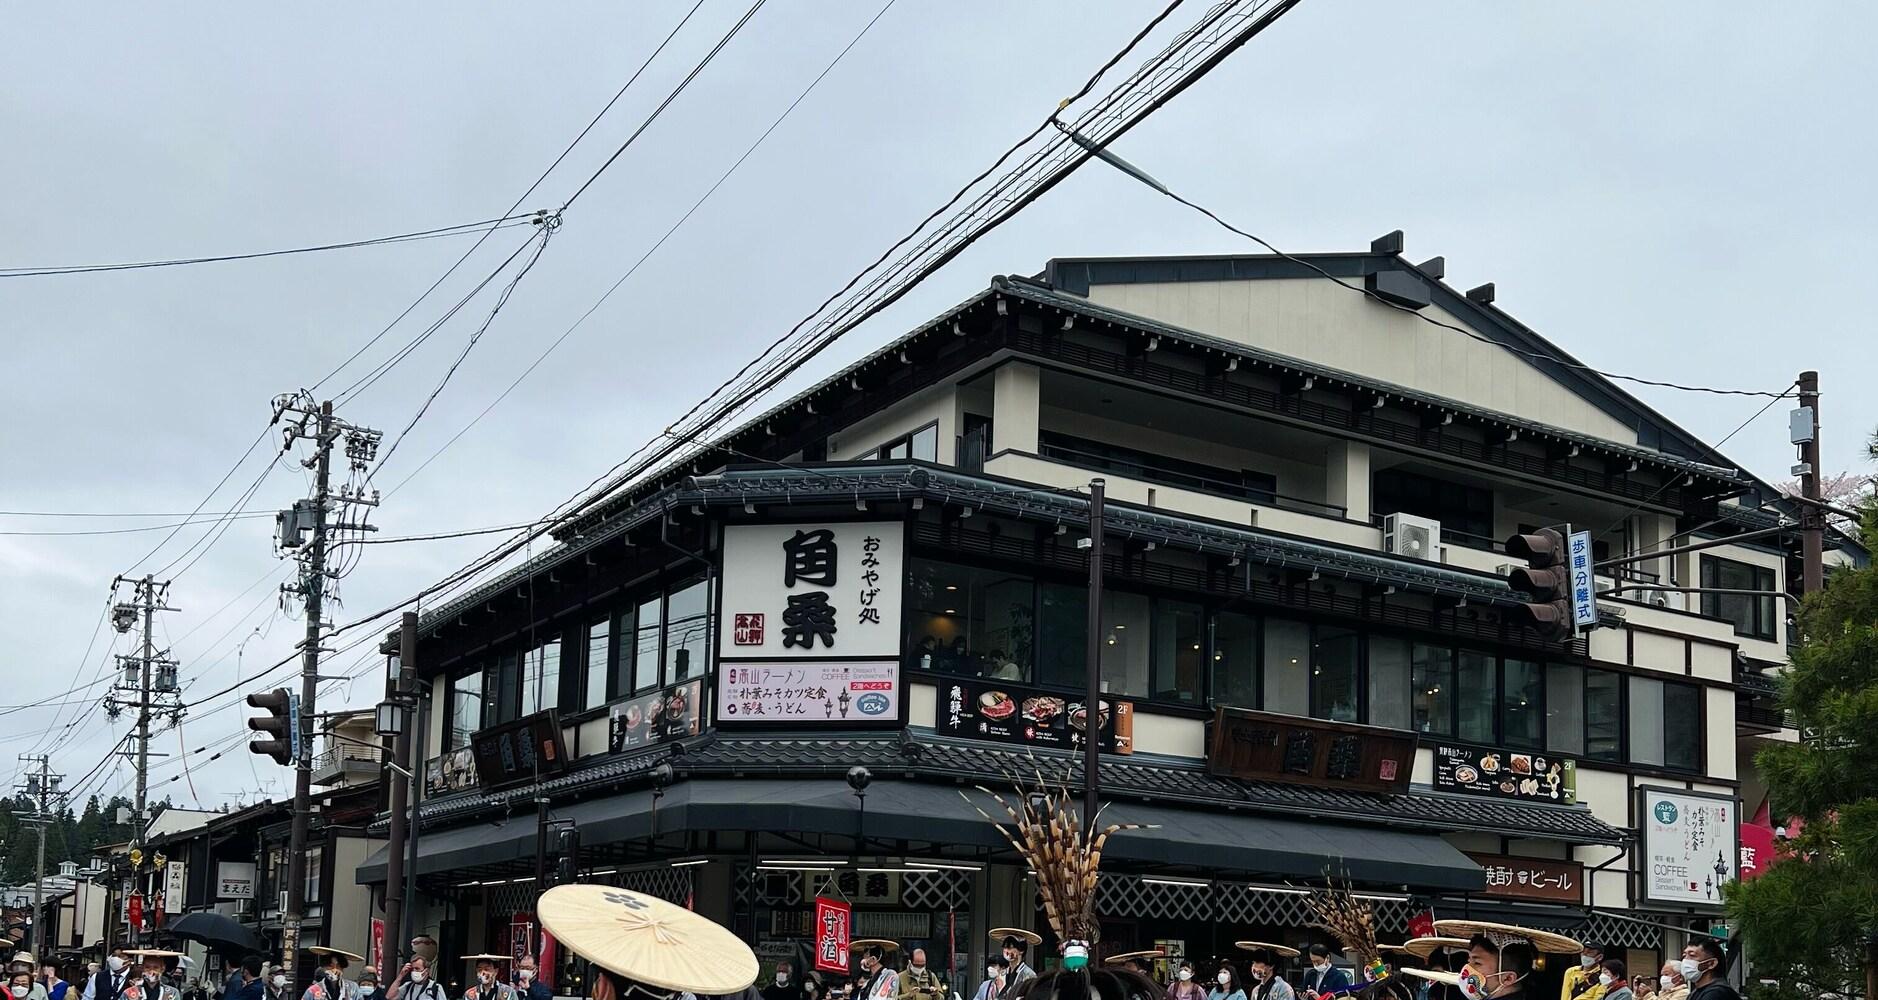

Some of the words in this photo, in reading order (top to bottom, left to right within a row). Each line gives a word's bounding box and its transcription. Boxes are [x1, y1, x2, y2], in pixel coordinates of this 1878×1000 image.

[858, 535, 881, 625] おみやげ処
[1572, 539, 1591, 619] 歩車分離式
[781, 529, 838, 649] 角桑
[738, 668, 806, 685] 高山ラーメン
[822, 673, 850, 681] COFFEE
[739, 686, 828, 700] 朴葉みそカツ定食
[1117, 704, 1129, 715] 2F
[1654, 864, 1689, 878] COFFEE
[1531, 869, 1573, 891] ビール
[222, 884, 250, 895] まえだ
[821, 910, 838, 963] 甘酒
